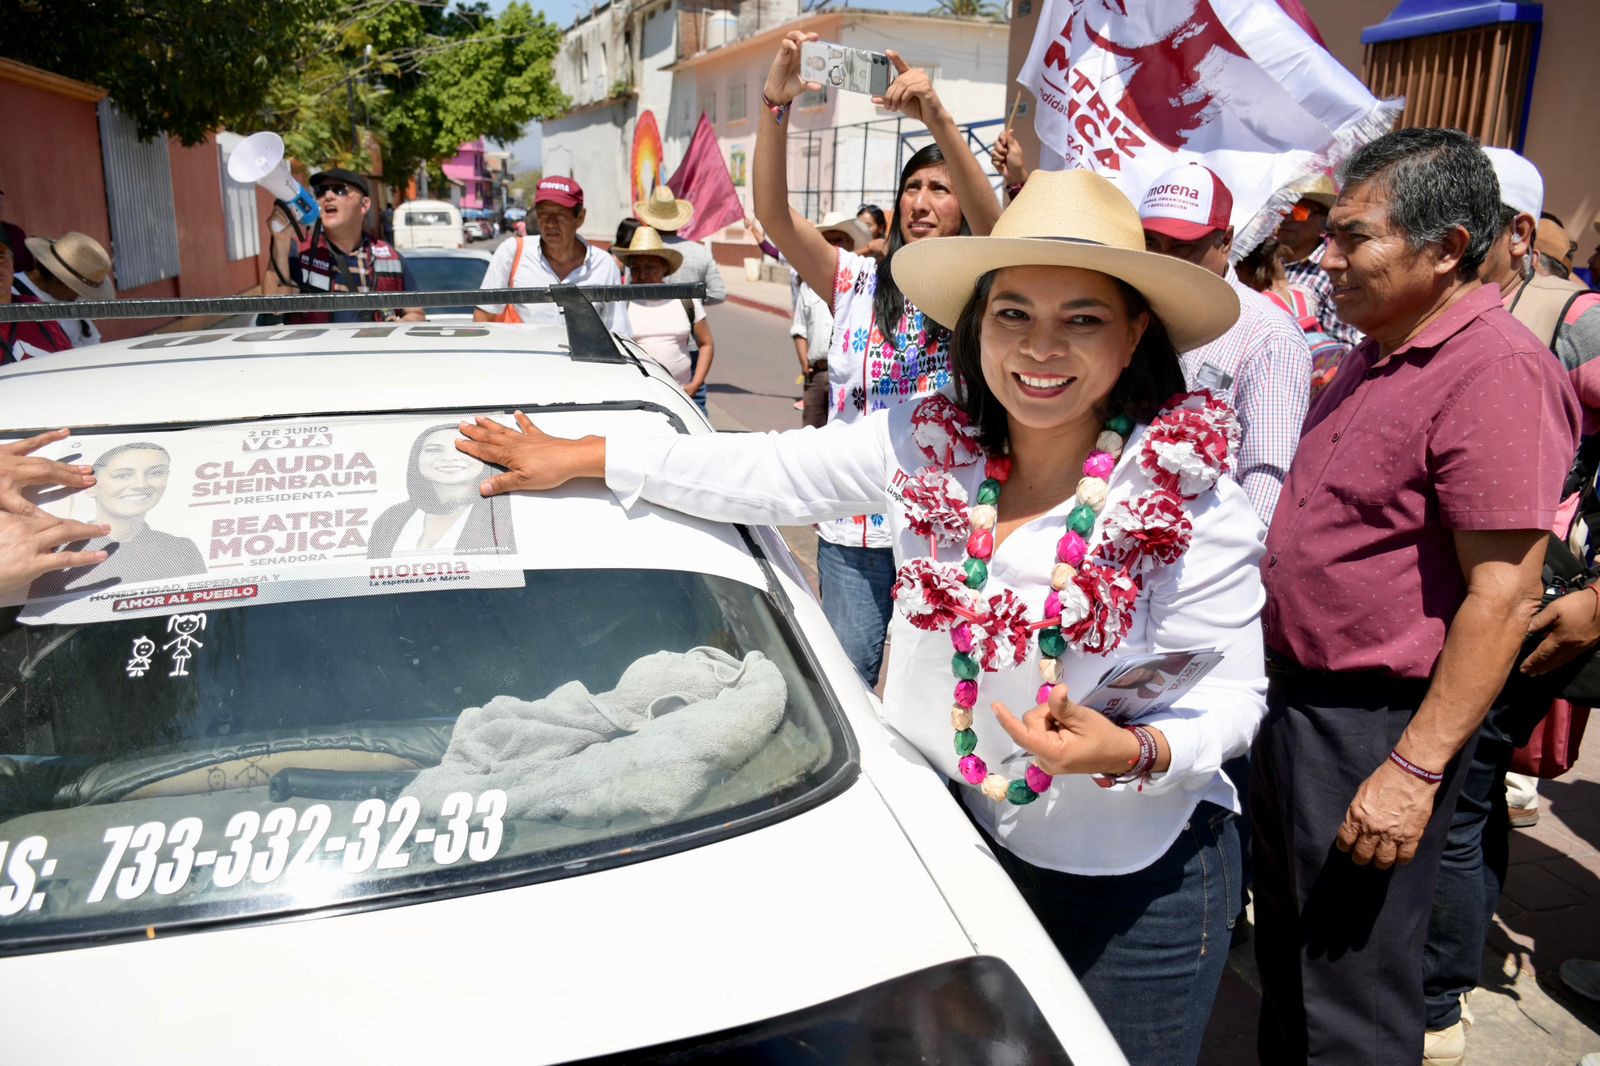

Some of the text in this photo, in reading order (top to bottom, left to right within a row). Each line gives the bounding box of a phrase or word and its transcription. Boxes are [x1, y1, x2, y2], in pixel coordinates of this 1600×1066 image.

[540, 182, 570, 192] morena
[1147, 183, 1200, 200] morena
[127, 326, 491, 350] 0015
[248, 425, 329, 438] 2 DE JUNIO
[246, 434, 331, 450] VOTA
[194, 451, 375, 481] CLAUDIA
[191, 470, 377, 497] SHEINBAUM
[233, 490, 334, 505] PRESIDENTA
[211, 508, 368, 538] BEATRIZ
[208, 528, 368, 560] MOJICA
[249, 553, 327, 567] SENADORA
[369, 560, 469, 580] morena
[186, 575, 268, 590] ESPERANZA
[272, 573, 281, 582] Y
[382, 577, 425, 587] esperanza
[440, 574, 470, 582] México
[117, 586, 255, 611] AMOR AL PUEBLO
[87, 789, 507, 903] 733-332-32-33
